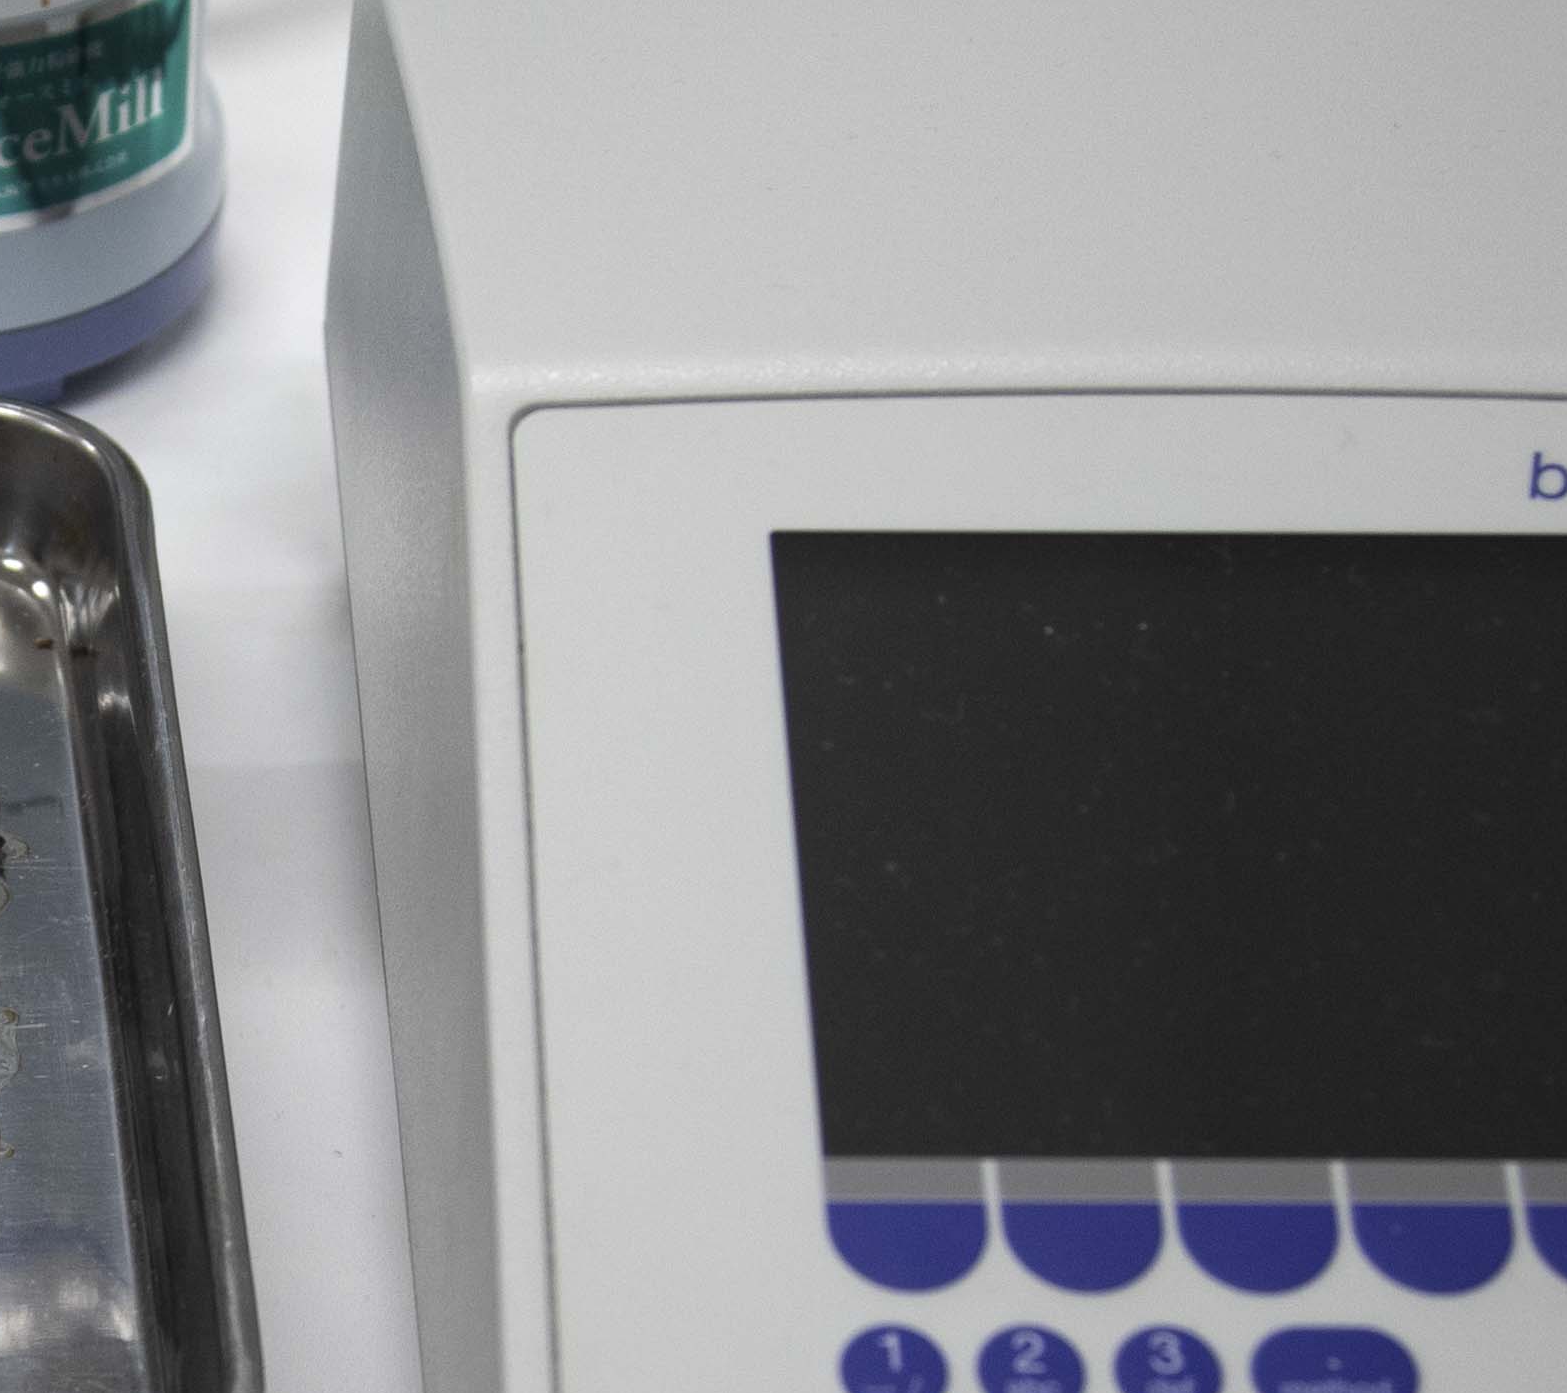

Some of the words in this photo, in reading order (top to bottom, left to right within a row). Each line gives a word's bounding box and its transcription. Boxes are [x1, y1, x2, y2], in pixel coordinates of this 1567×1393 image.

[879, 1332, 903, 1374] 1
[1012, 1330, 1046, 1375] 2
[1147, 1330, 1185, 1375] 3
